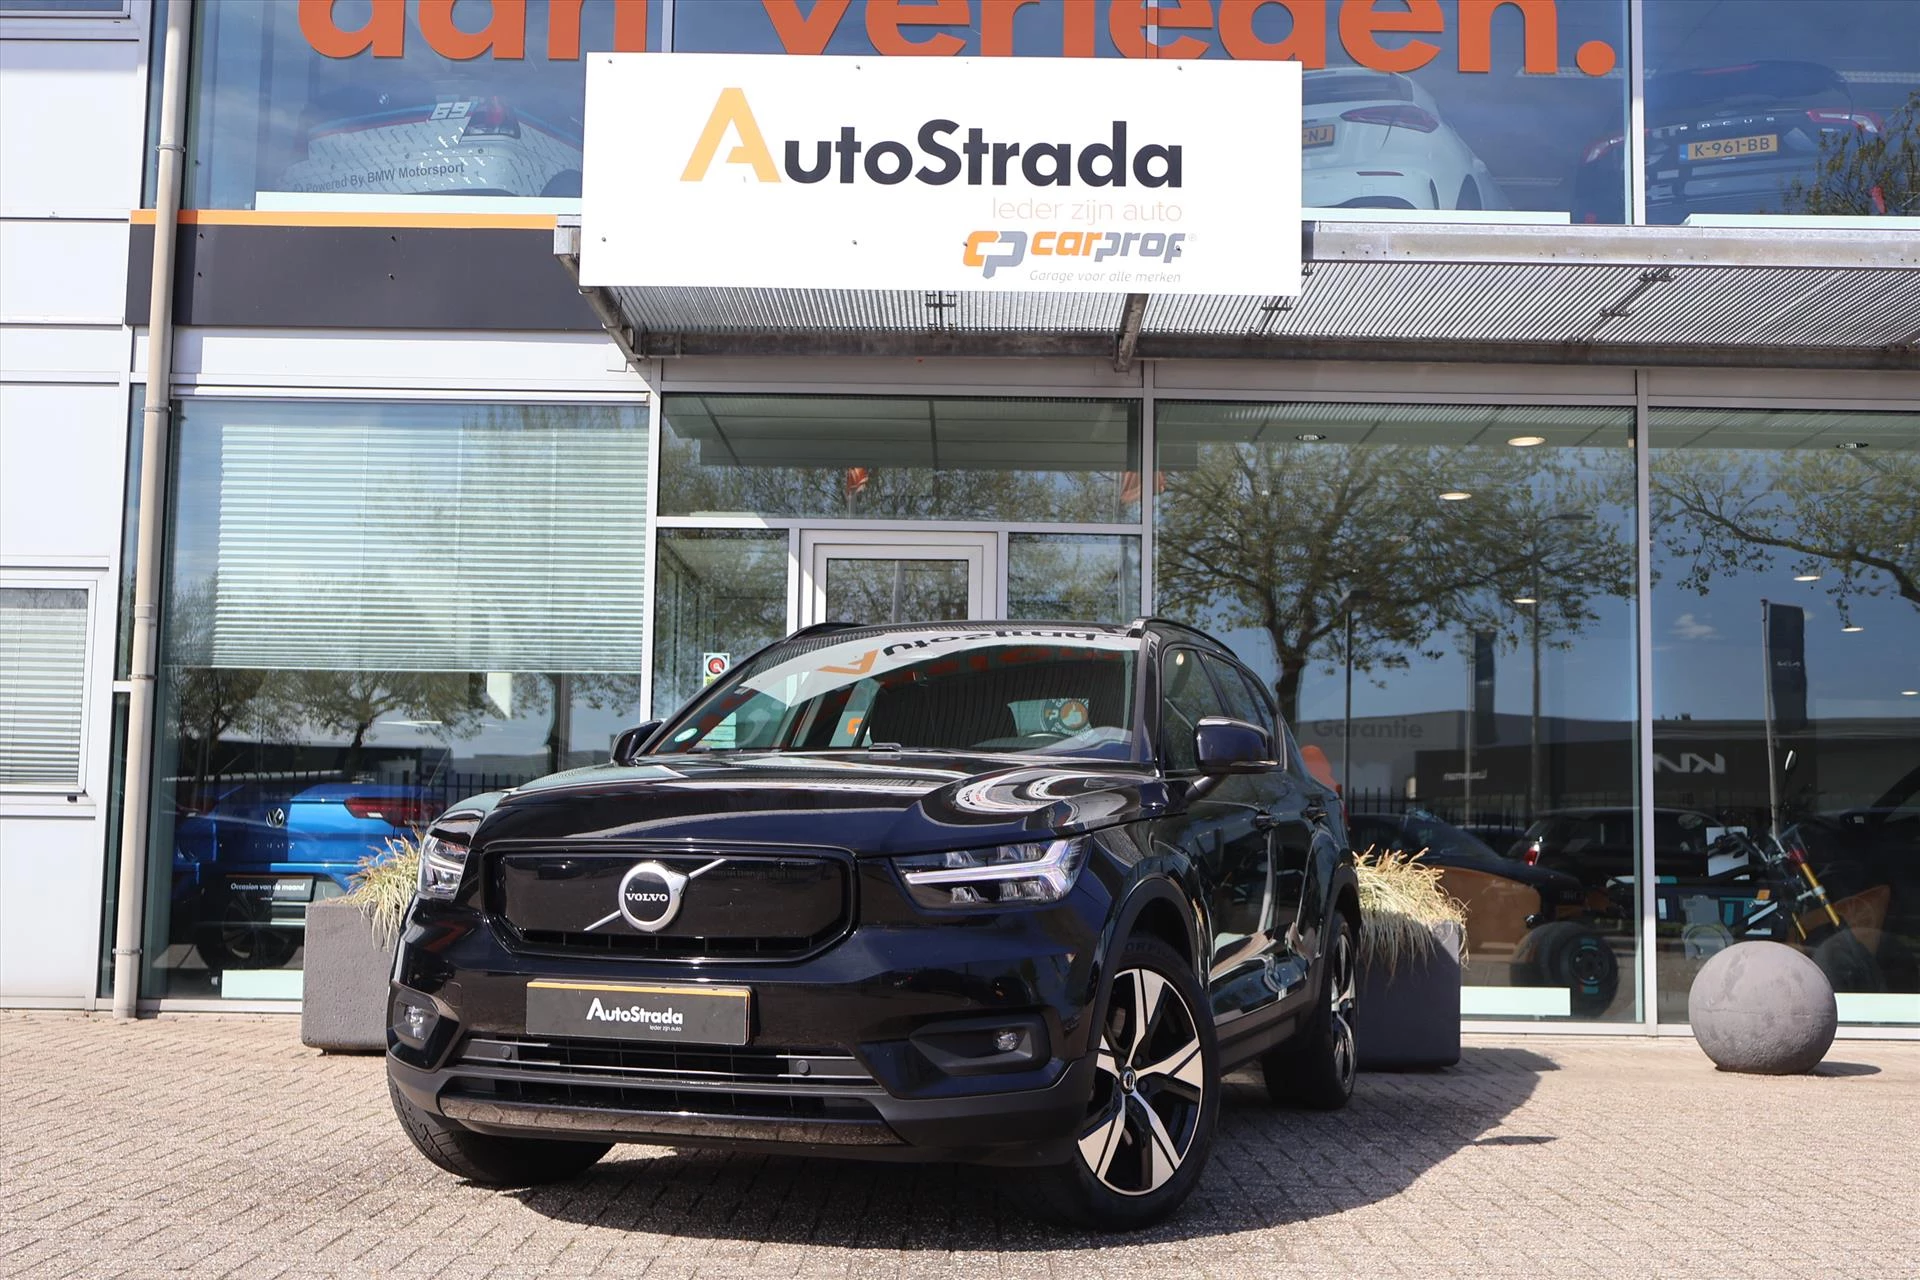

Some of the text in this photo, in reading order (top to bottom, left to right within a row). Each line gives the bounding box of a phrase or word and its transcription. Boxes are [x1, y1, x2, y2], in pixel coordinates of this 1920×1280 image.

[430, 102, 472, 120] 69
[679, 87, 1183, 189] AutoStrada
[1694, 137, 1770, 157] K-961-BB
[305, 175, 348, 192] Powered
[350, 174, 366, 187] By
[367, 168, 396, 183] BMW
[398, 162, 465, 180] Motorsport
[992, 197, 1183, 226] Ieder zijn auto
[1029, 270, 1182, 284] Garage voor alle merken
[1313, 718, 1425, 739] Garantie
[230, 882, 259, 891] Occasion
[625, 892, 669, 902] VOLVO
[585, 996, 684, 1025] AutoStrada
